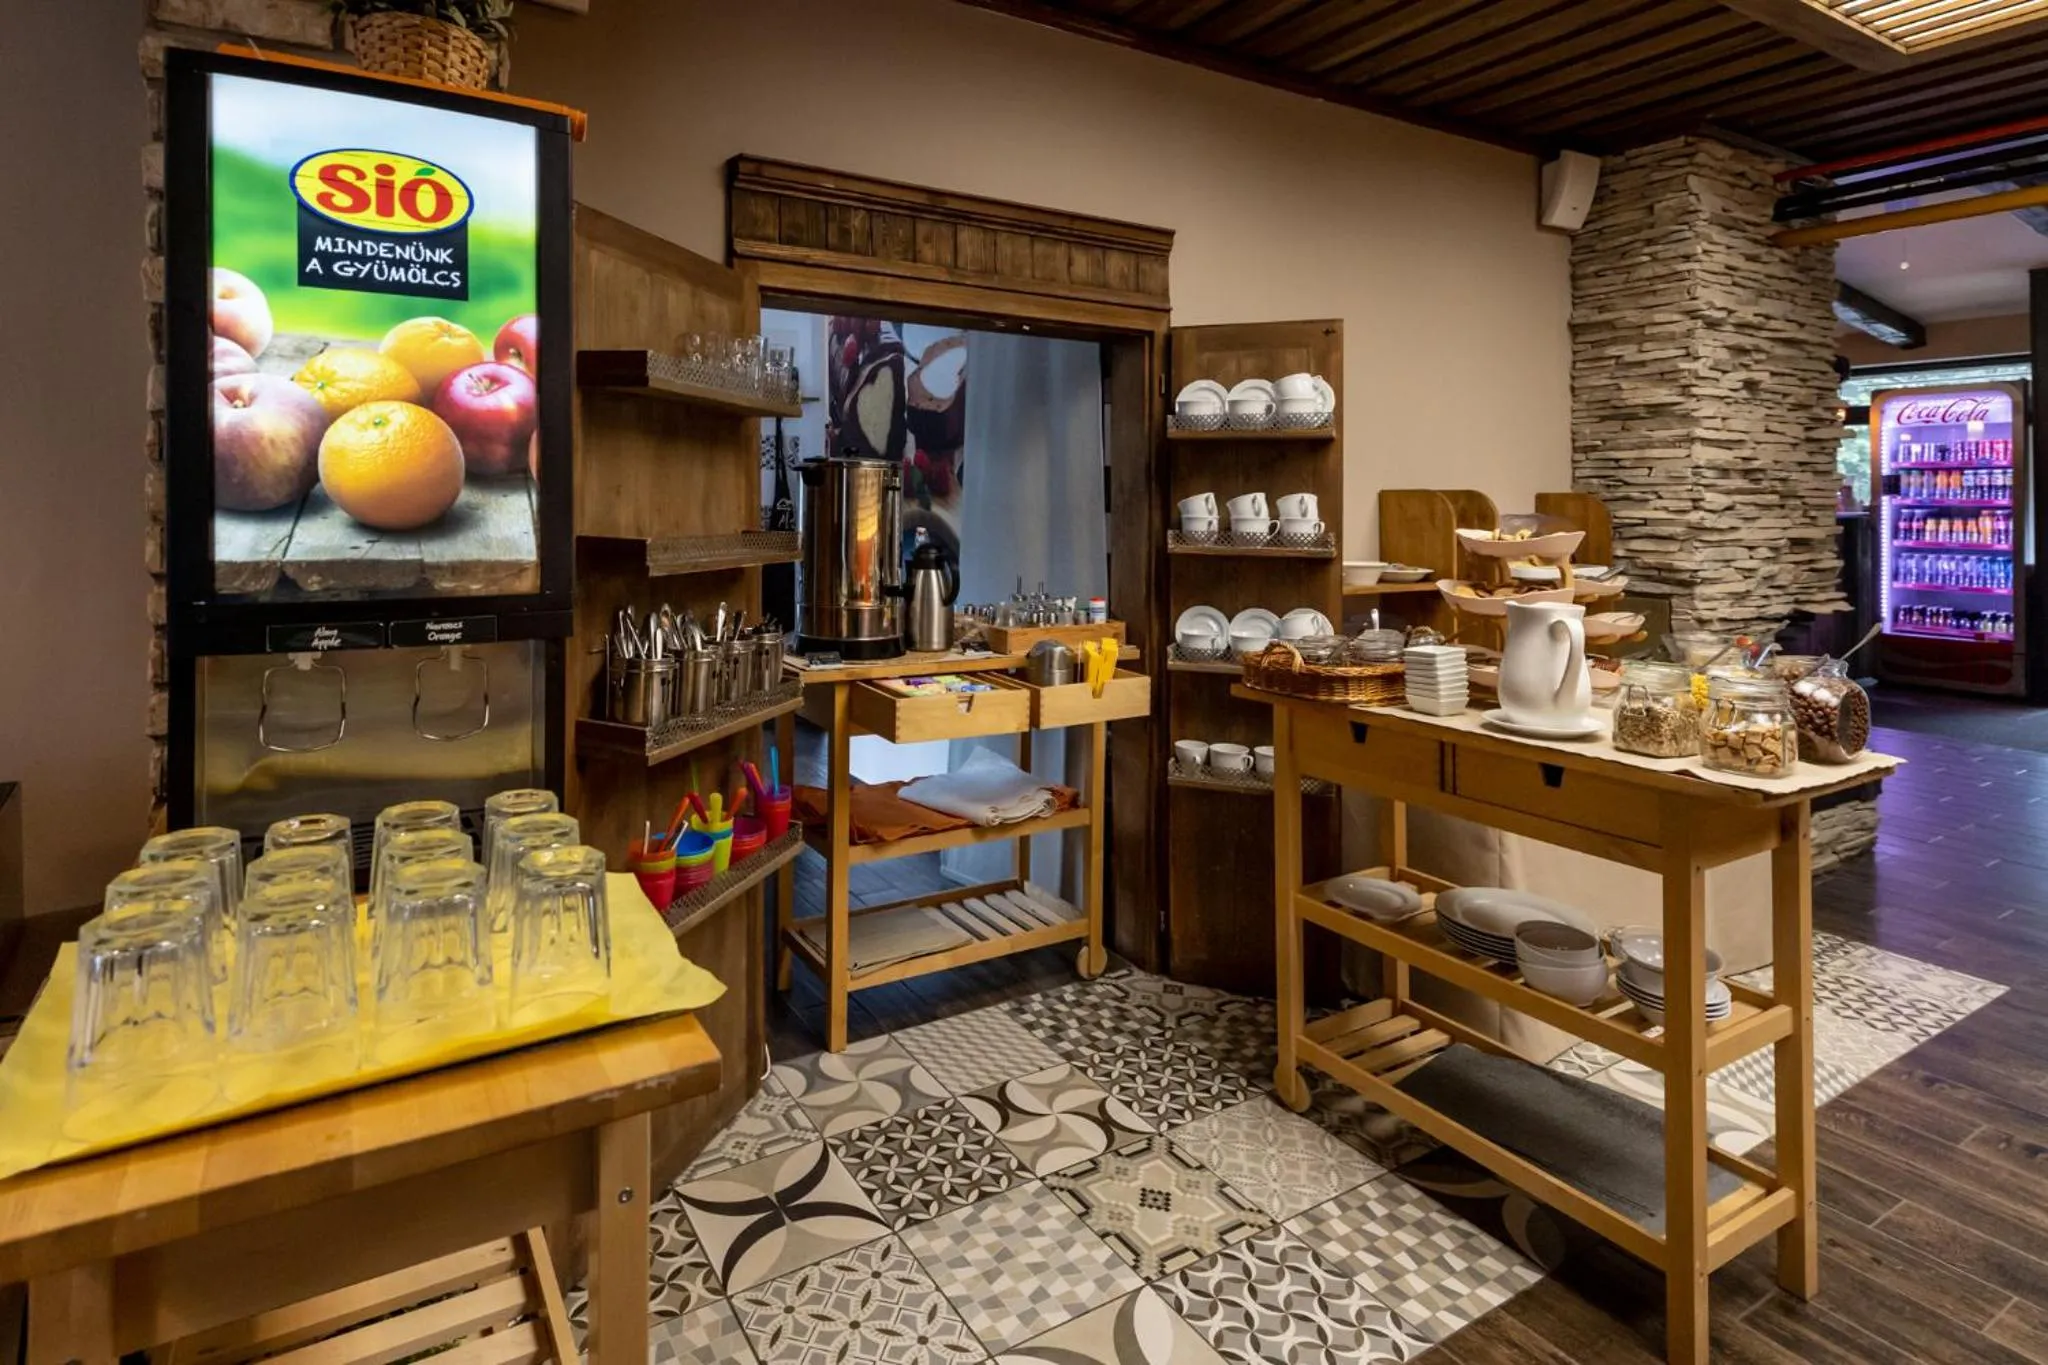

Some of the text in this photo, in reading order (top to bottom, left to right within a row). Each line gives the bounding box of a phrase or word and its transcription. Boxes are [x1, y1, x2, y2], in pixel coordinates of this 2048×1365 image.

[314, 236, 454, 264] MINDENÜNK
[305, 257, 461, 287] A GYÜMÖLCS
[427, 631, 463, 643] Orange
